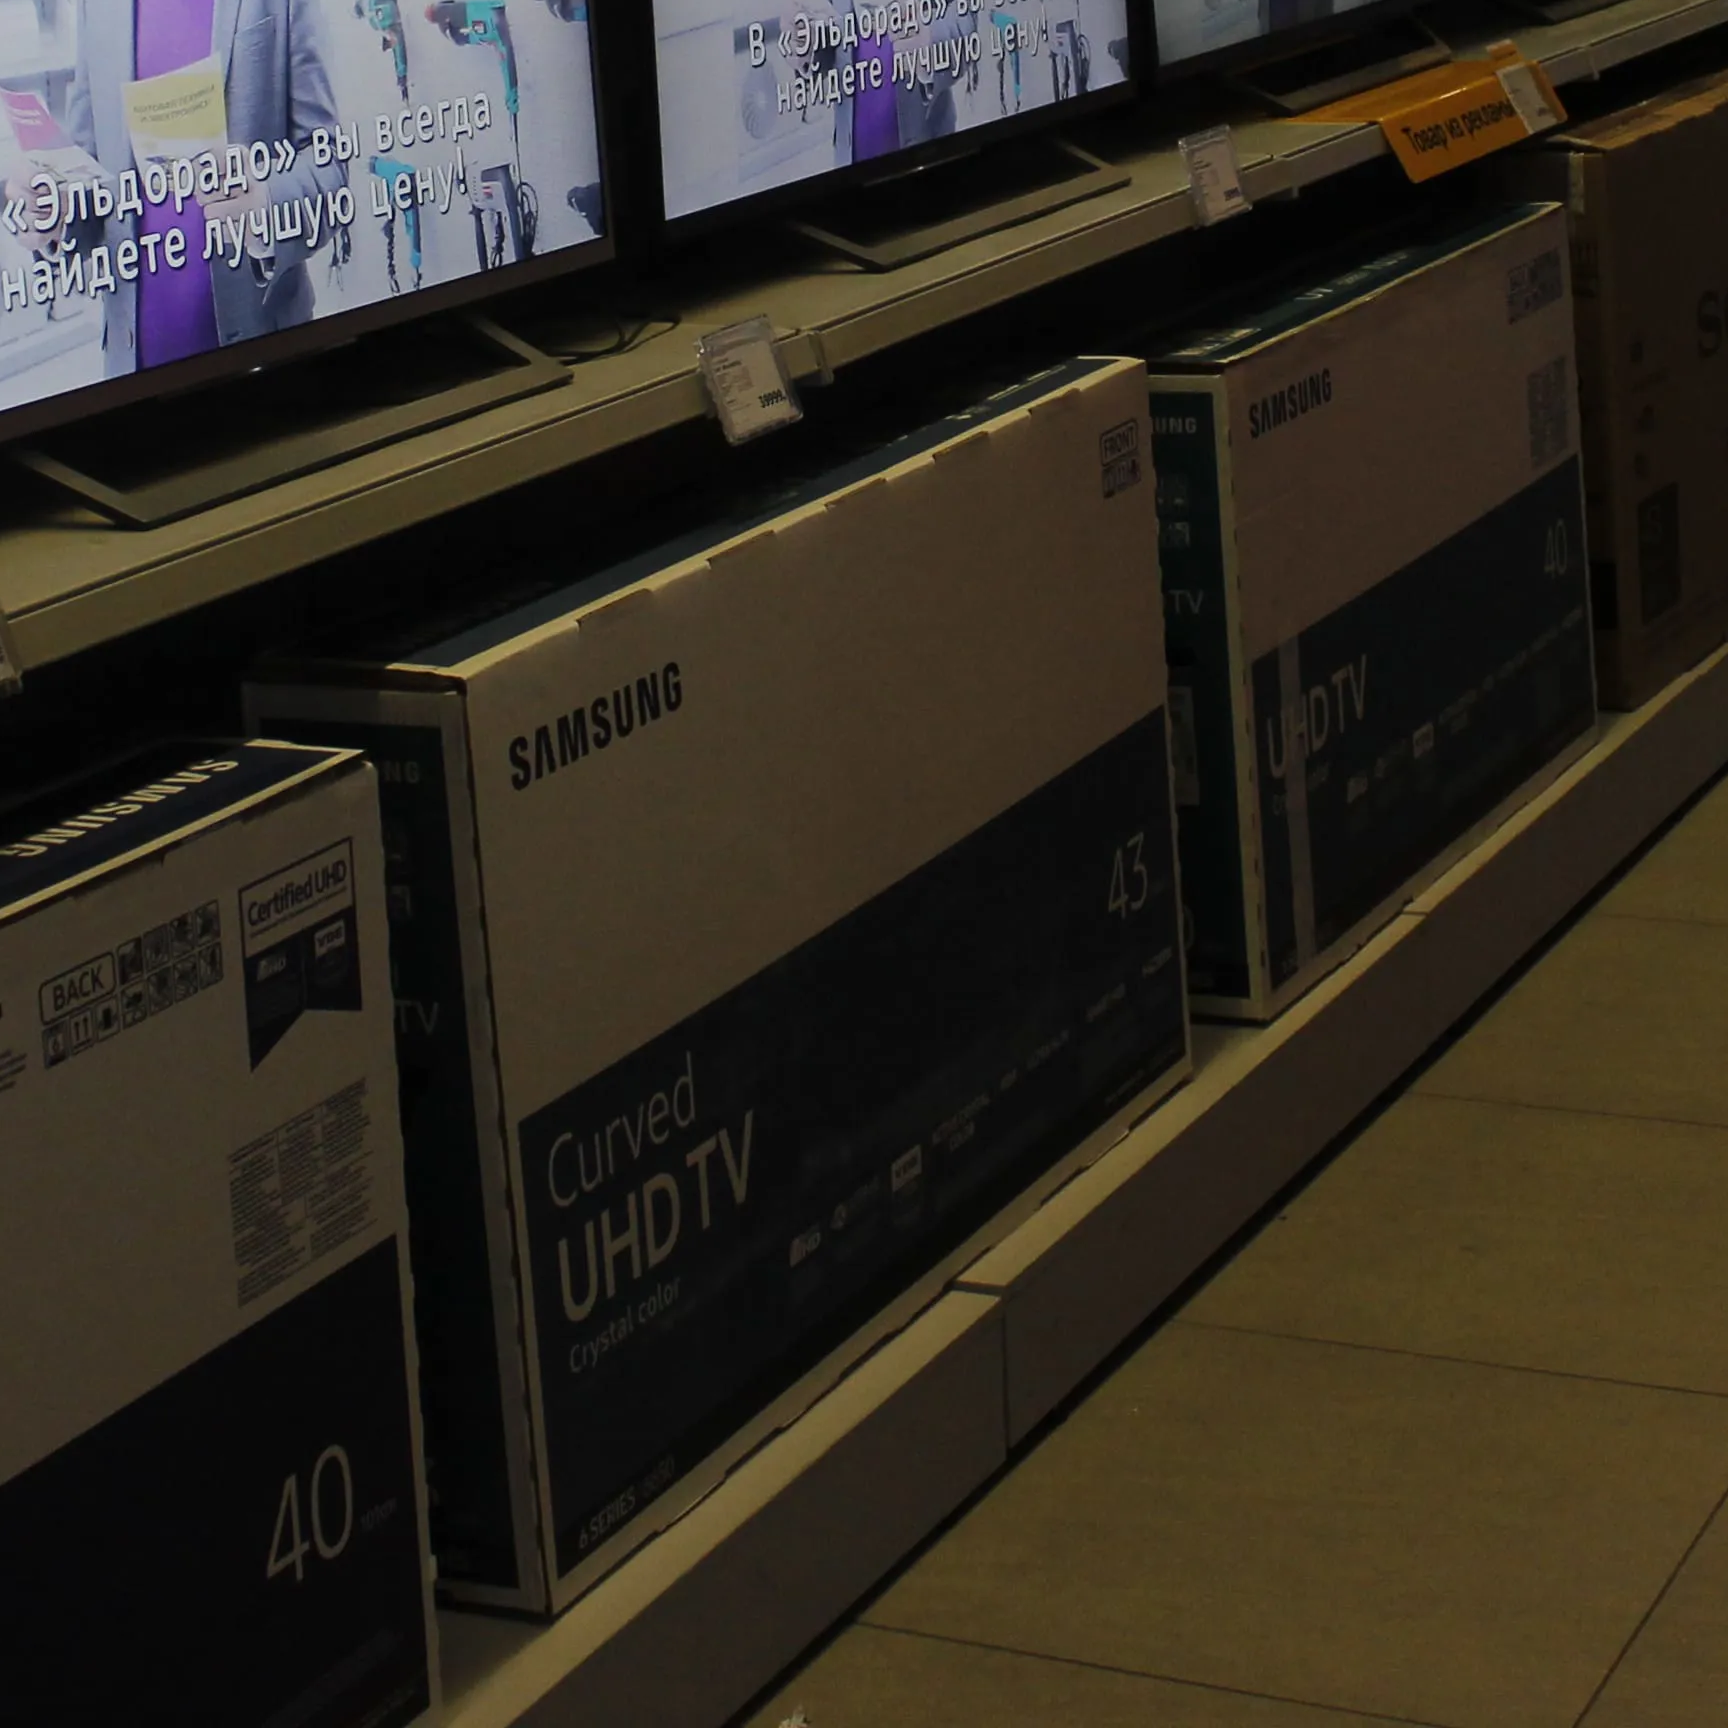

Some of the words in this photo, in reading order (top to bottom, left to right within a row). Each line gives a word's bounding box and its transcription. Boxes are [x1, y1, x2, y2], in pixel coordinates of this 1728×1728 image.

[748, 22, 767, 68] В
[777, 57, 884, 115] найдете
[891, 30, 982, 90] лучшую
[991, 6, 1049, 57] цену!
[1, 138, 297, 233] «Эльдорадо»
[312, 120, 360, 168] вы
[375, 91, 492, 154] всегда
[1401, 124, 1449, 156] Товар
[1, 225, 186, 313] найдете
[202, 187, 355, 269] лучшую
[371, 145, 469, 221] цену!
[1249, 367, 1333, 440] SAMSUNG
[1542, 517, 1568, 579] 40
[511, 661, 684, 790] SAMSUNG
[1331, 652, 1368, 735] TV
[248, 875, 314, 927] Certified
[313, 858, 348, 895] UHD
[1107, 831, 1149, 921] 43
[53, 964, 106, 1012] BACK
[546, 1049, 698, 1209] Curved
[556, 1171, 683, 1323] UHD
[685, 1108, 755, 1232] TV
[569, 1302, 636, 1375] Crystal
[637, 1276, 683, 1326] color
[266, 1442, 354, 1585] 40
[588, 1485, 637, 1543] SERIES
